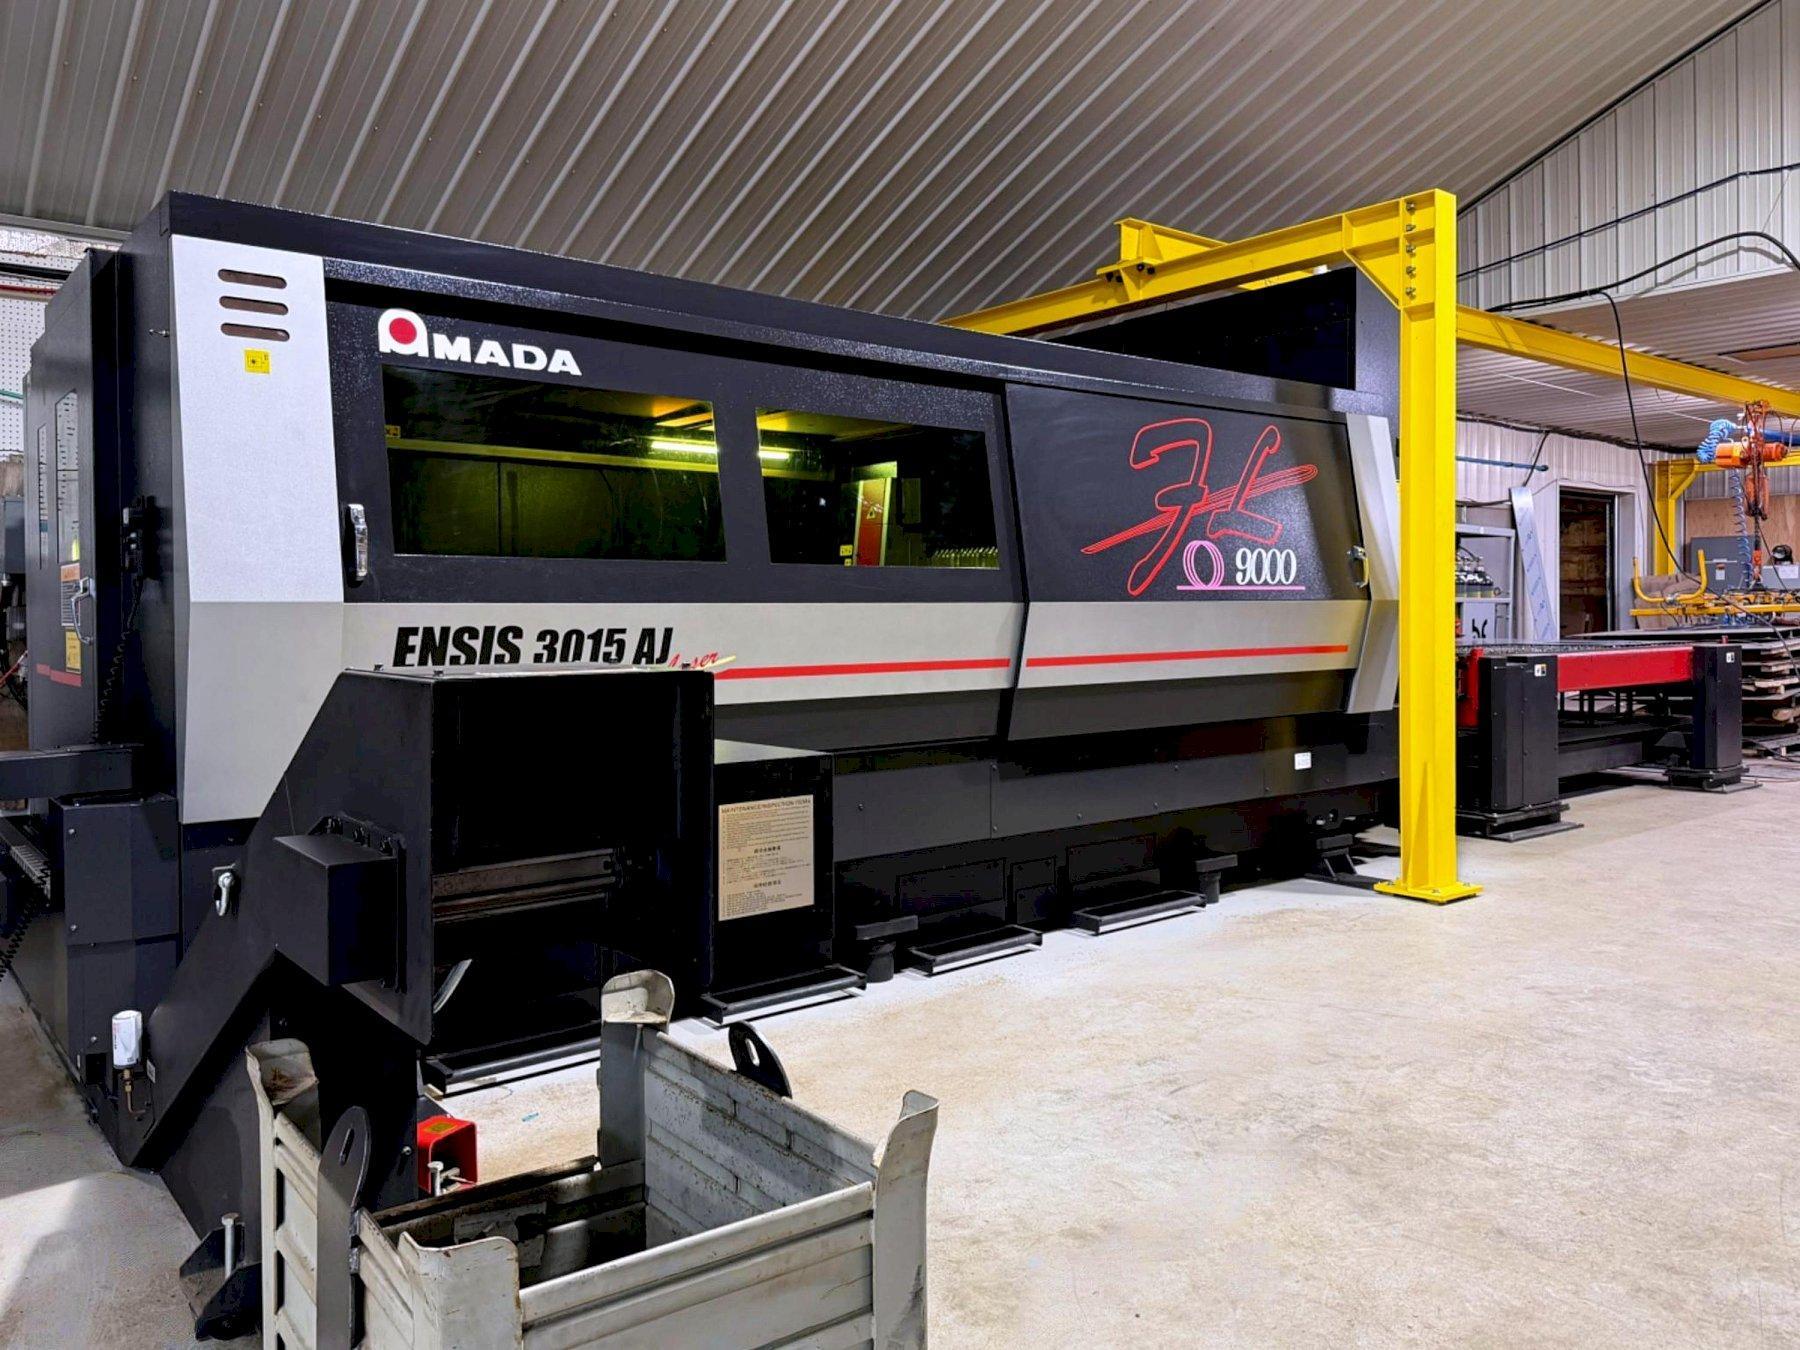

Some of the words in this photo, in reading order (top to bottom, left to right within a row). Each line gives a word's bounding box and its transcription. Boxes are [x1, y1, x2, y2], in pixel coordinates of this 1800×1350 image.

[378, 308, 583, 376] AMADA
[1235, 547, 1297, 585] 9000
[392, 625, 524, 667] ENSIS
[533, 628, 627, 663] 3015
[632, 627, 674, 664] AJ
[668, 652, 719, 668] ser
